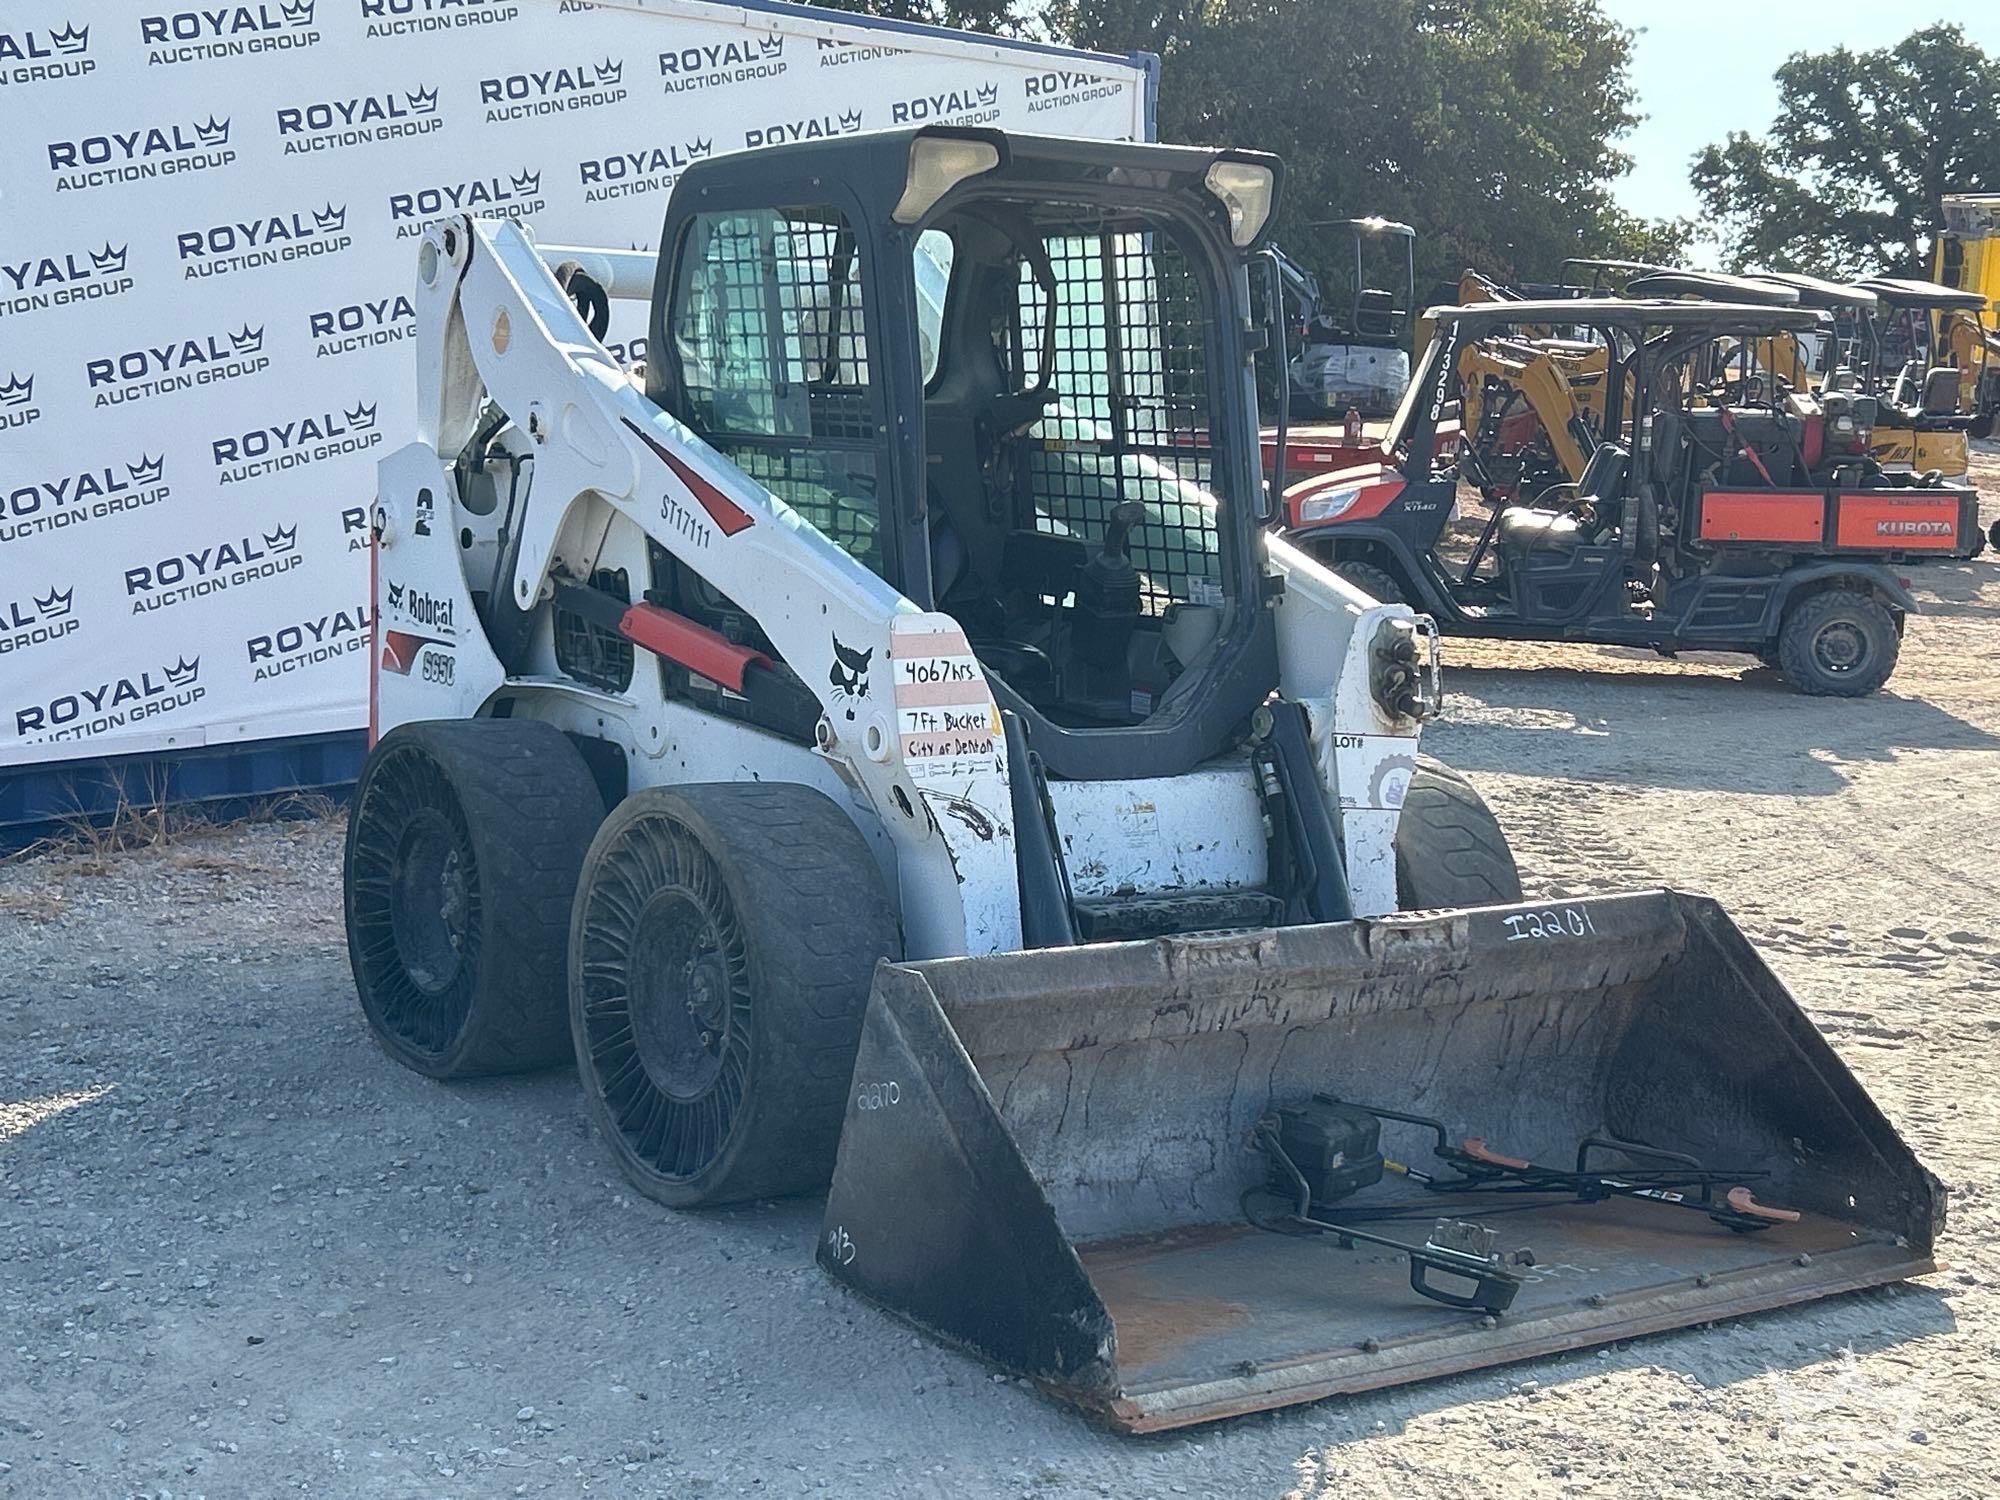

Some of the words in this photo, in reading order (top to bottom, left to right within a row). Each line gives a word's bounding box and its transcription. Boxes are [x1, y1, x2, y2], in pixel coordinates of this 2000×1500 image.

[141, 4, 282, 44] ROYAL
[366, 15, 452, 39] AUCTION
[455, 8, 519, 28] GROUP
[148, 39, 244, 67] AUCTION
[247, 31, 321, 54] GROUP
[658, 40, 760, 77] ROYAL
[820, 46, 882, 68] AUCTION
[13, 59, 96, 84] GROUP
[480, 66, 596, 104] ROYAL
[664, 70, 733, 95] AUCTION
[734, 62, 788, 83] GROUP
[277, 94, 407, 136] ROYAL
[486, 99, 565, 124] AUCTION
[567, 89, 628, 110] GROUP
[892, 89, 977, 124] ROYAL
[1027, 93, 1080, 113] AUCTION
[1081, 83, 1123, 102] GROUP
[48, 126, 196, 171] ROYAL
[284, 129, 372, 156] AUCTION
[376, 118, 444, 142] GROUP
[56, 163, 158, 193] AUCTION
[161, 151, 237, 176] GROUP
[579, 145, 688, 185] ROYAL
[390, 178, 512, 220] ROYAL
[585, 177, 660, 203] AUCTION
[177, 213, 315, 260] ROYAL
[1, 254, 92, 292] YAL
[184, 250, 278, 281] AUCTION
[281, 236, 353, 262] GROUP
[53, 277, 135, 306] GROUP
[309, 296, 416, 339] ROYA
[87, 336, 231, 388] ROYAL
[316, 327, 403, 359] AUCTION
[94, 374, 193, 409] AUCTION
[196, 356, 270, 386] GROUP
[212, 413, 346, 466] ROYAL
[219, 451, 311, 486] AUCTION
[313, 432, 384, 461] GROUP
[0, 507, 89, 541] UCTION
[92, 486, 171, 518] GROUP
[1876, 521, 1953, 536] KUBOTA
[124, 538, 266, 596] ROYAL
[132, 576, 228, 616] AUCTION
[231, 554, 303, 586] GROUP
[408, 588, 455, 627] Bobcat
[253, 642, 343, 683] AUCTION
[15, 672, 166, 736] ROYAL
[130, 686, 207, 721] GROUP
[906, 712, 919, 732] 7
[944, 711, 987, 732] Bucket
[908, 740, 934, 758] City
[938, 742, 951, 756] of
[954, 737, 994, 756] Denton
[1334, 736, 1364, 749] LOT#
